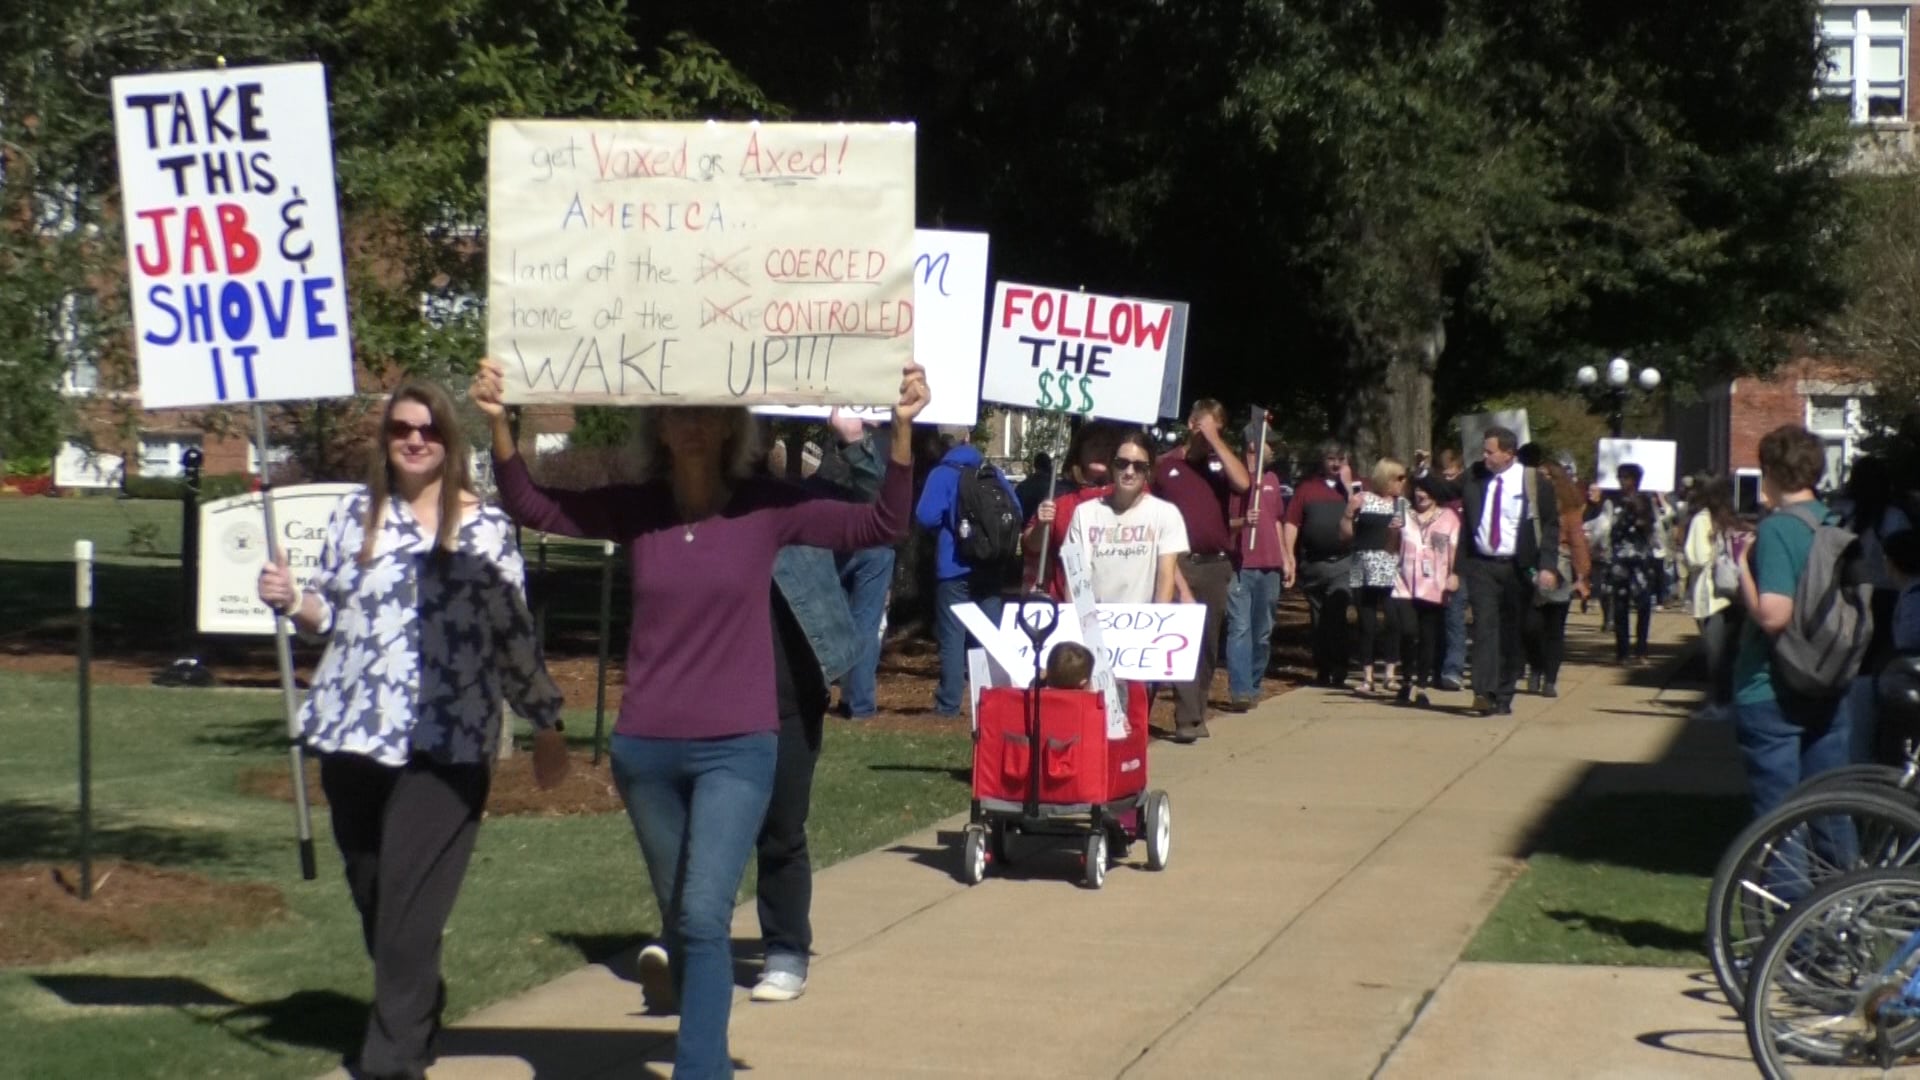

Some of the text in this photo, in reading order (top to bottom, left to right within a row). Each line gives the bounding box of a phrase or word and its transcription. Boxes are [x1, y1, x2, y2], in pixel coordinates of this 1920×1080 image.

[125, 83, 270, 149] TAKE
[158, 151, 278, 196] THIS
[532, 136, 580, 184] get
[591, 132, 689, 178] Vaxed
[739, 131, 849, 177] Axed!
[136, 186, 314, 276] JAB &
[512, 249, 568, 281] land
[586, 249, 615, 279] of
[629, 248, 678, 283] the
[765, 248, 886, 280] COERCED
[144, 277, 338, 346] SHOVE
[512, 298, 578, 331] home
[594, 300, 623, 329] of
[636, 300, 679, 331] the
[763, 300, 913, 335] CONTROLED
[1002, 288, 1173, 351] FOLLOW
[210, 345, 259, 400] IT
[512, 334, 836, 397] WAKE UP!!!
[1019, 336, 1112, 377] THE
[1036, 368, 1096, 413] $$$
